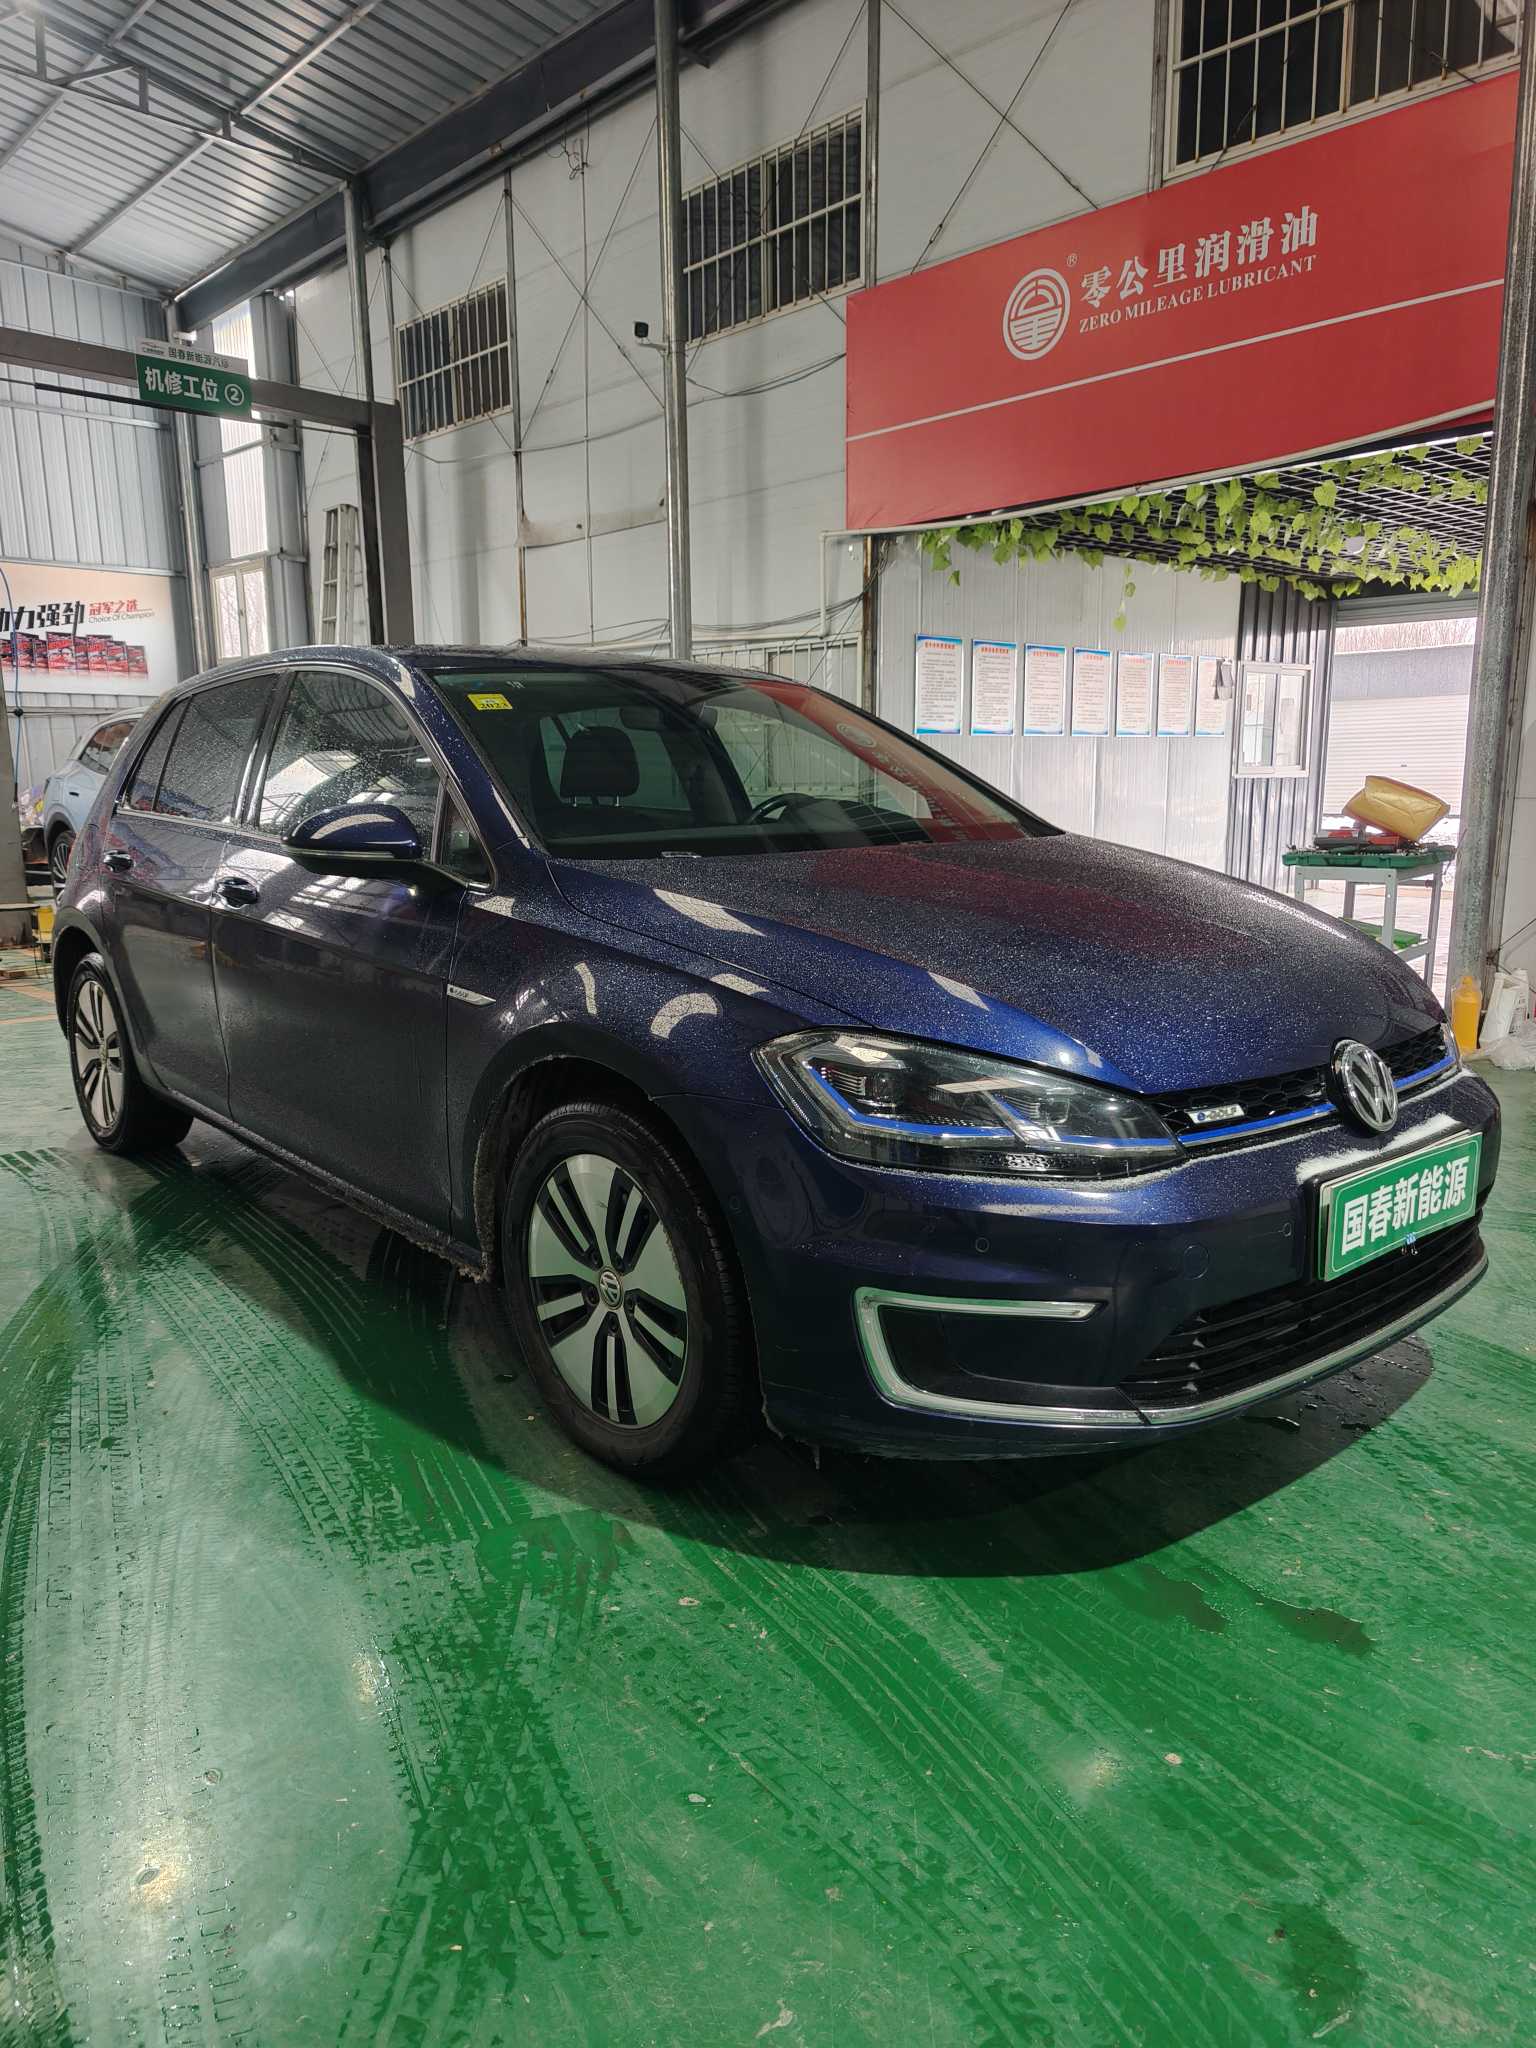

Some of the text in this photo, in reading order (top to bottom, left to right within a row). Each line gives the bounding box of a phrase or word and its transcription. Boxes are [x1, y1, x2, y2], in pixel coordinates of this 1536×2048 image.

[1079, 254, 1317, 333] ZERO MILEAGE LUBRICANT
[1080, 205, 1319, 308] 零公里润滑油
[144, 366, 220, 402] 机修工位
[88, 615, 112, 624] Choice
[121, 611, 155, 621] Champion
[1341, 1156, 1471, 1256] 国春新能源
